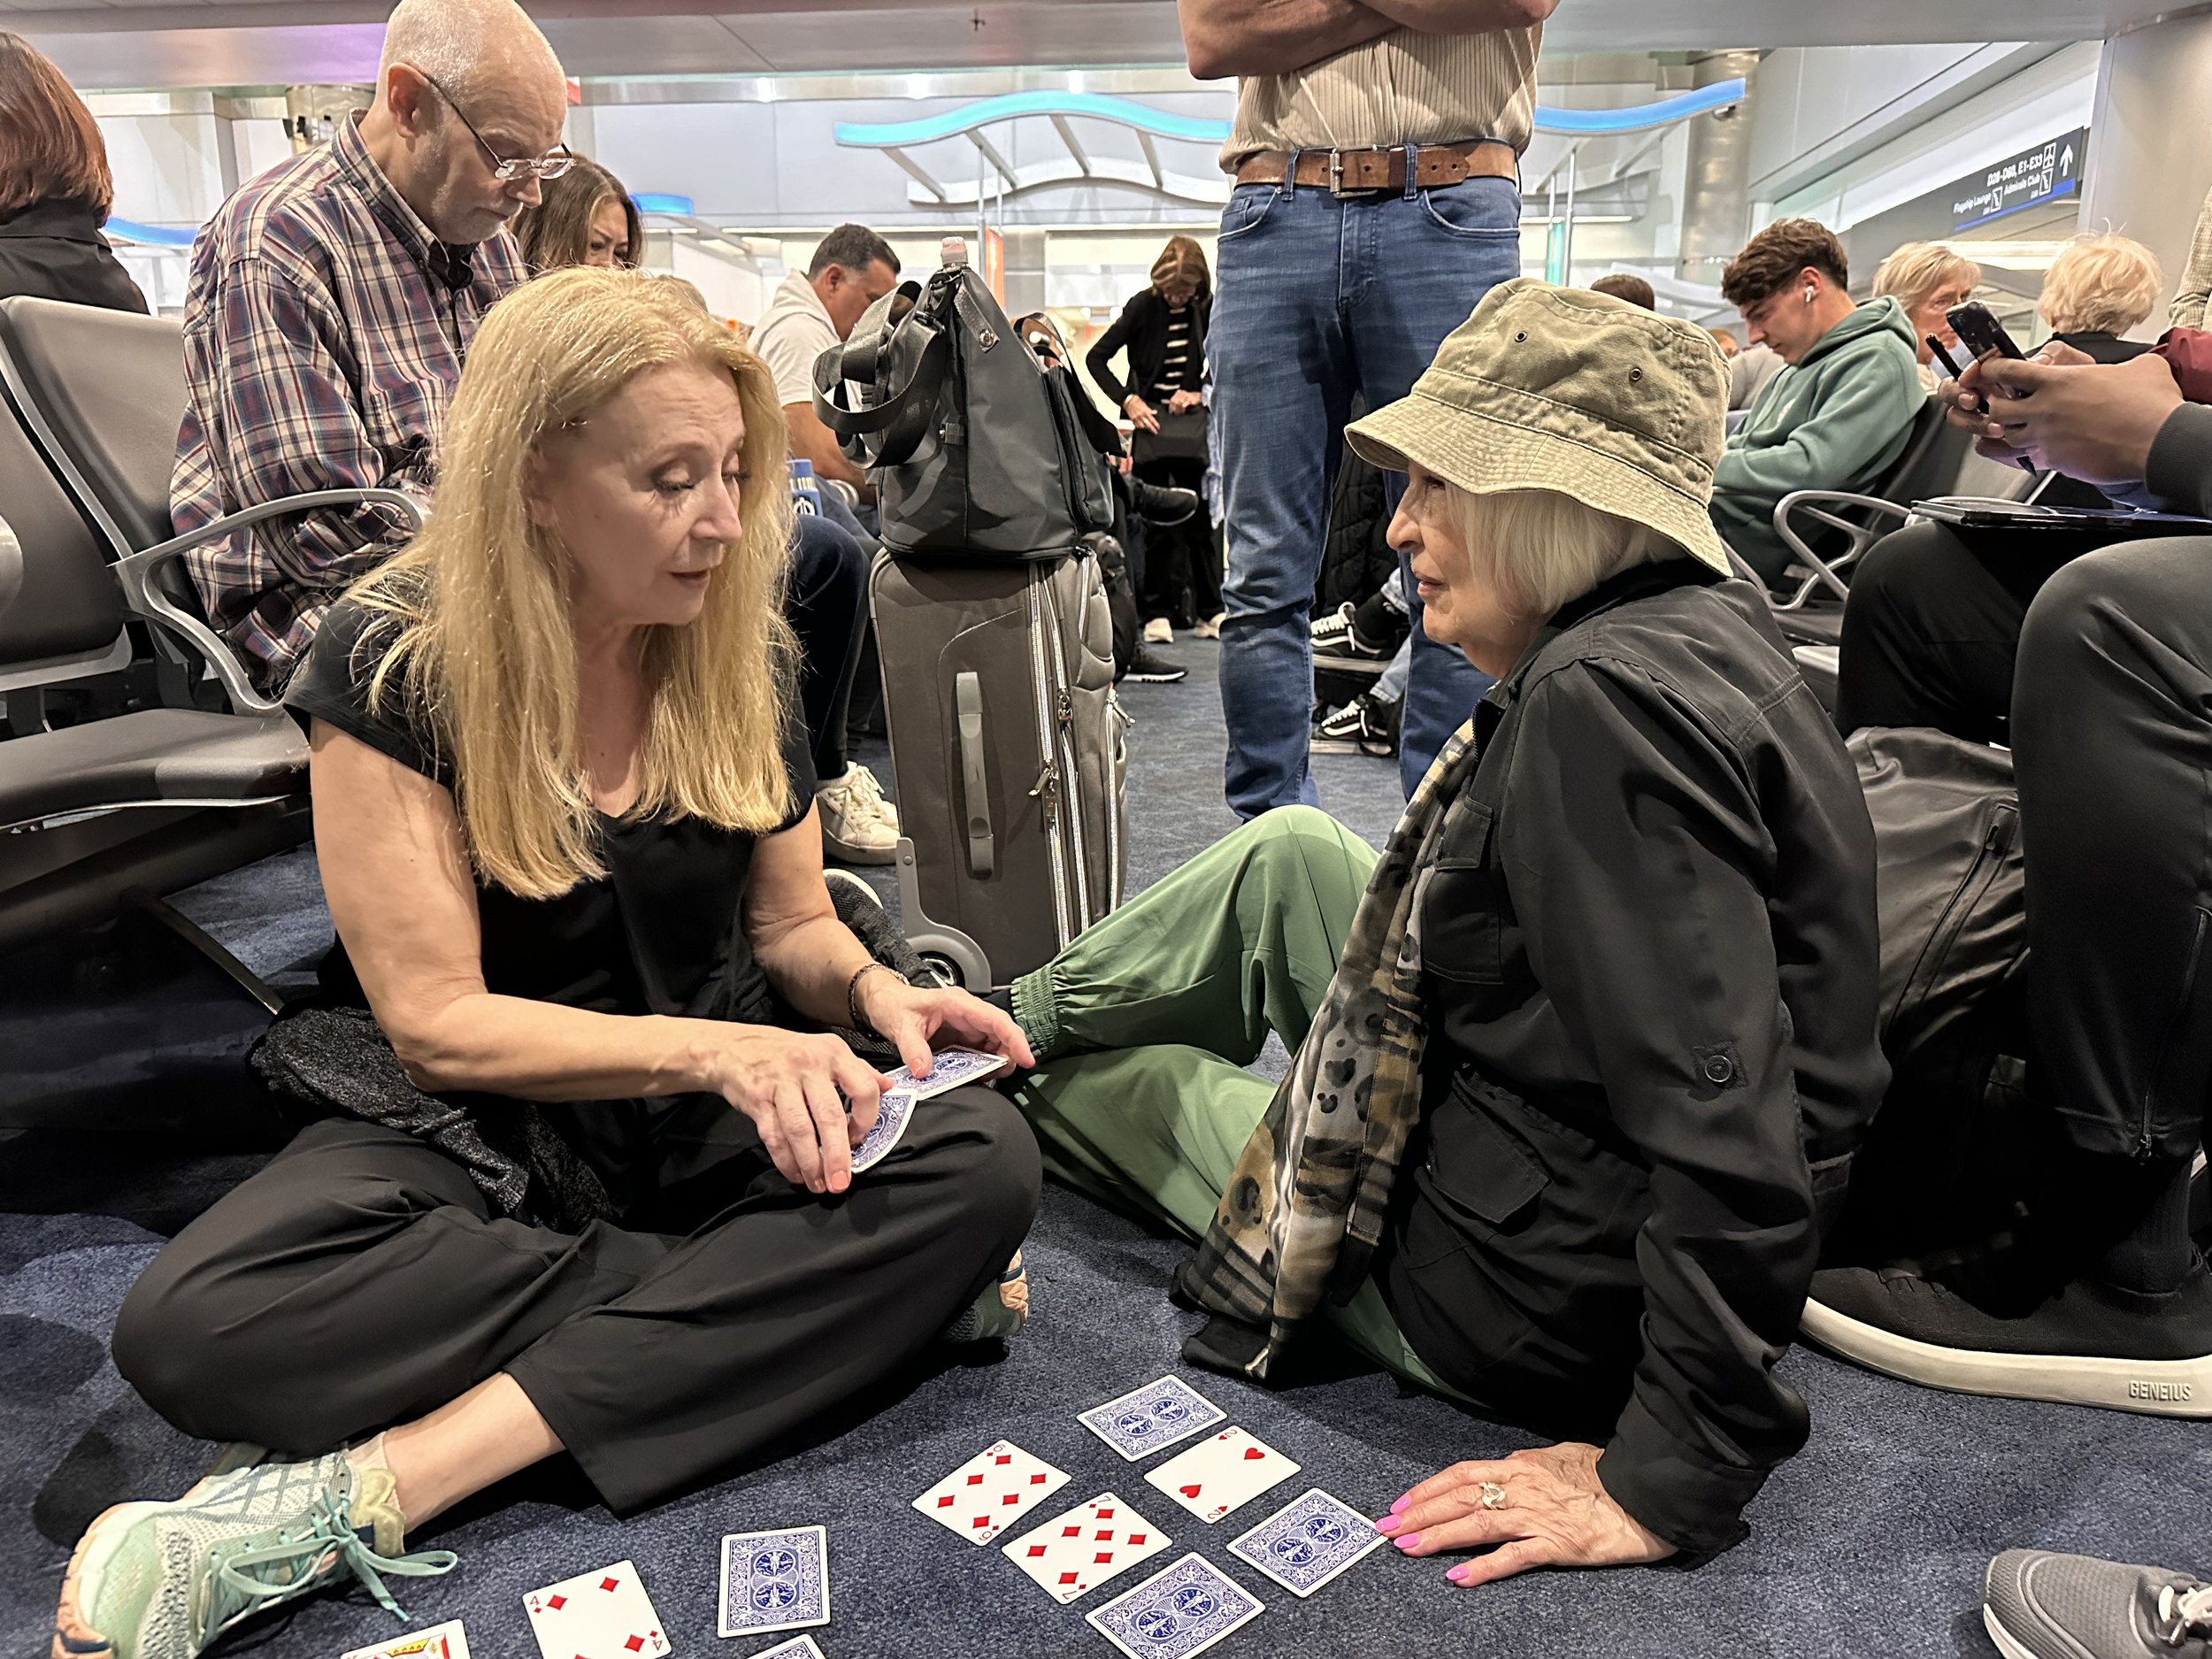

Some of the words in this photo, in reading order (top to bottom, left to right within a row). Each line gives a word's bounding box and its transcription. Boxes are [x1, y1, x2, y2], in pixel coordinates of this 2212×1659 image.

[2018, 153, 2043, 174] E1-E33
[2004, 179, 2027, 195] Admirals
[2028, 173, 2040, 187] Club
[1954, 198, 1973, 213] Flagship
[1974, 192, 1992, 206] Lounge
[2129, 1379, 2193, 1402] GENEIUS
[1224, 1429, 1238, 1438] 2
[993, 1443, 1006, 1452] 6
[1207, 1509, 1222, 1520] 2
[979, 1531, 994, 1541] 6
[529, 1595, 541, 1606] 4
[1062, 1590, 1078, 1601] 7
[651, 1640, 664, 1652] 4
